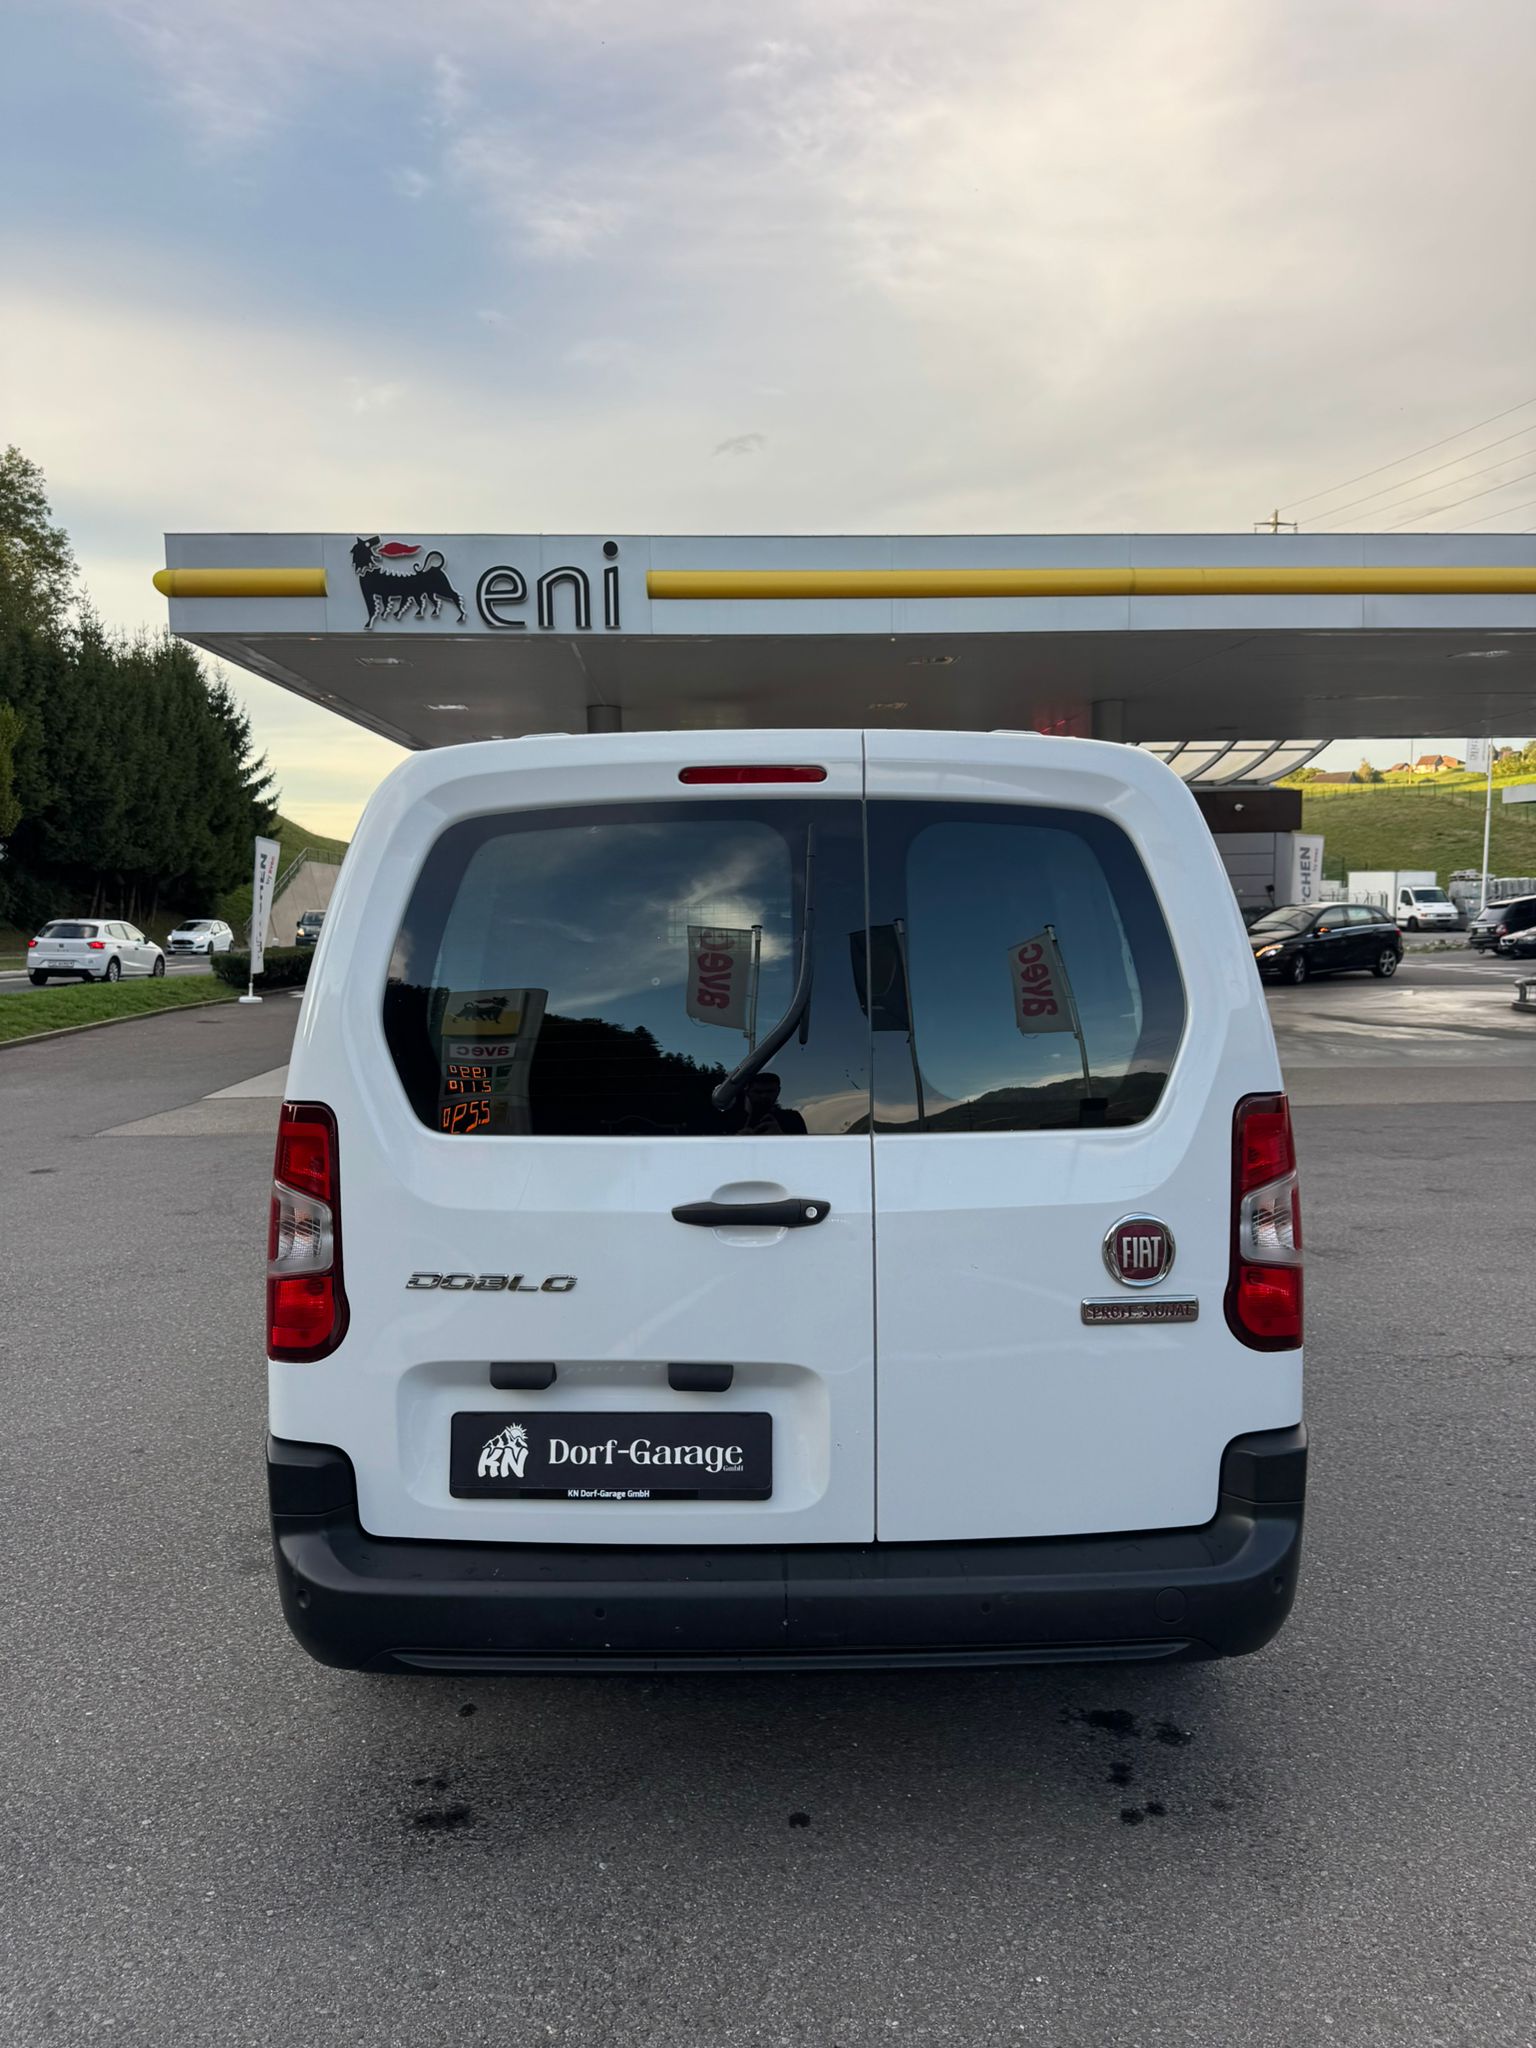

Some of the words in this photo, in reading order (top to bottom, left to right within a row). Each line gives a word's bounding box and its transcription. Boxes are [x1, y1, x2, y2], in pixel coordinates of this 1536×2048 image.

[476, 541, 620, 629] eni
[1122, 1236, 1162, 1268] FIAT
[477, 1446, 529, 1478] KN
[548, 1438, 744, 1473] Dorf-Garage
[567, 1489, 580, 1498] KN
[580, 1489, 626, 1500] Dorf-Garage
[627, 1489, 650, 1498] GmbH
